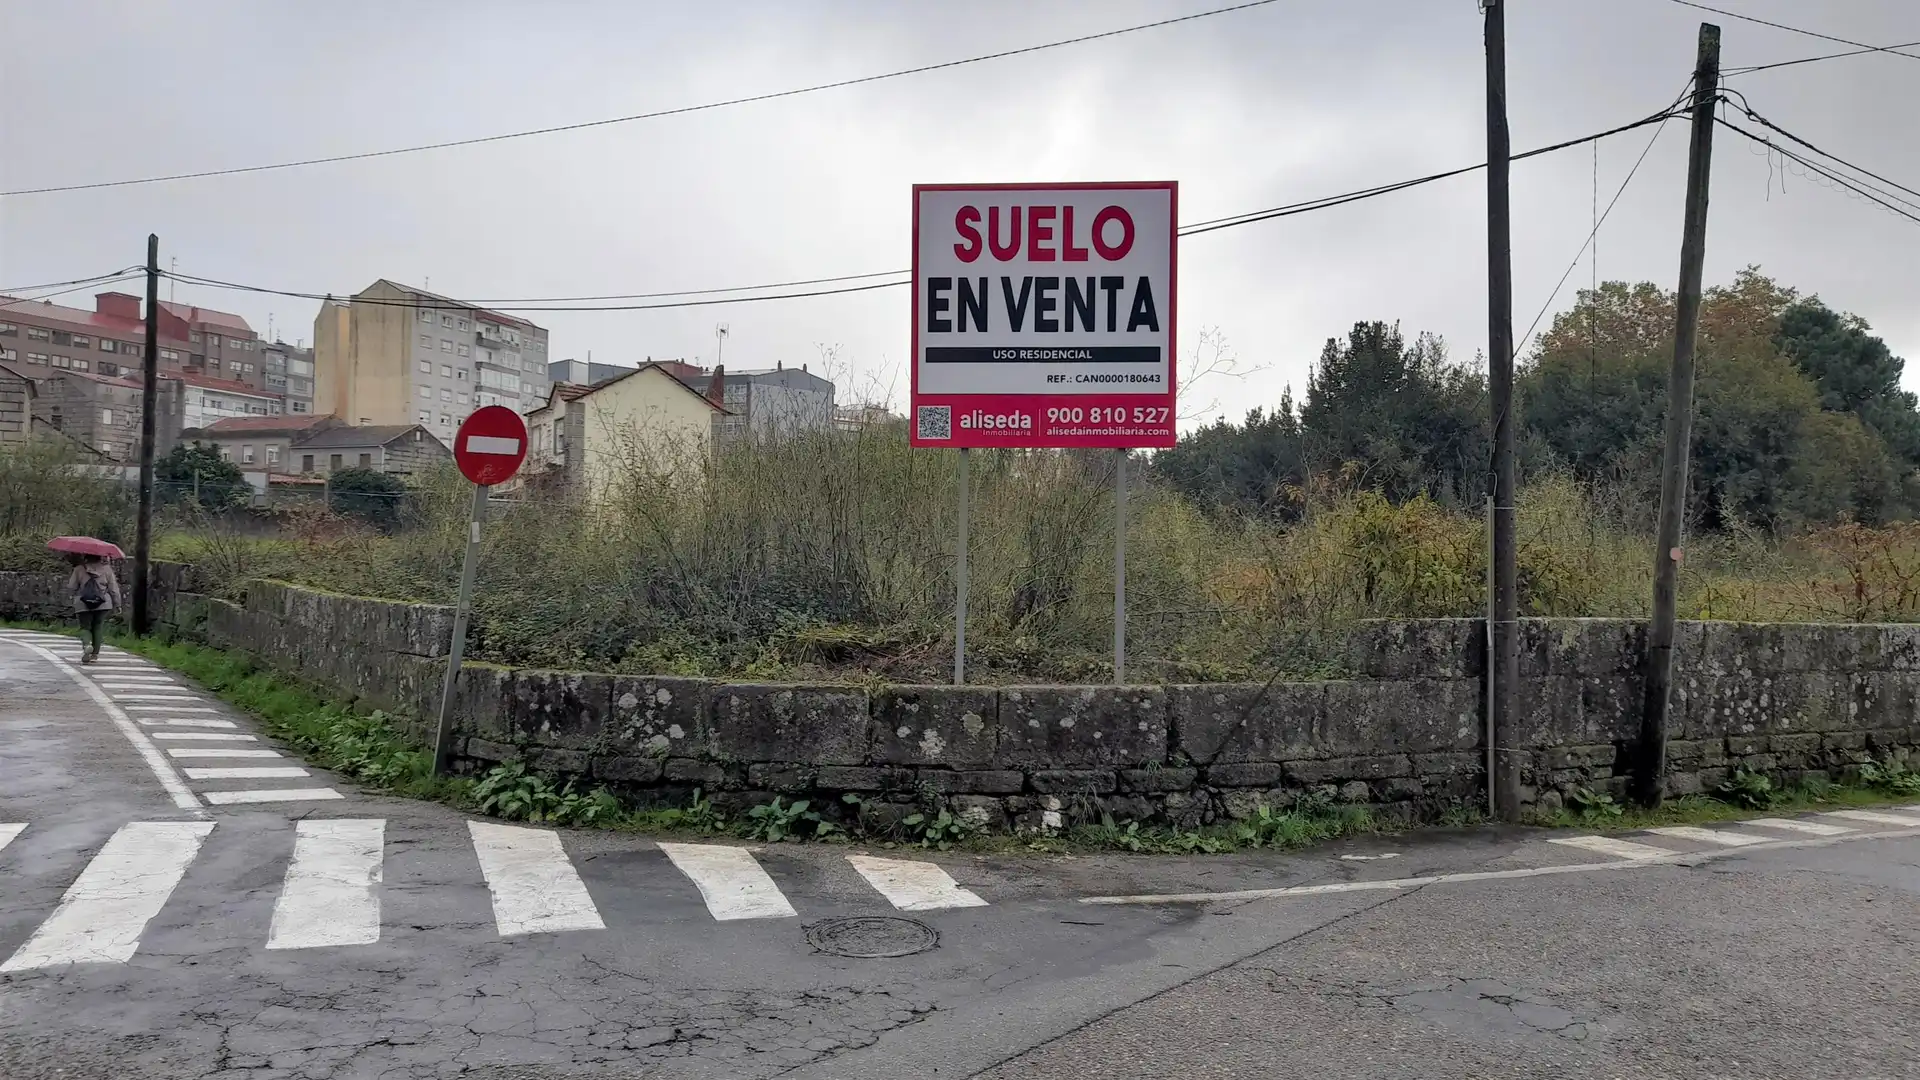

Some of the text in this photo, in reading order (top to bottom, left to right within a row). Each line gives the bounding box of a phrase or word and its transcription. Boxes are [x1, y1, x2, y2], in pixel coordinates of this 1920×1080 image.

[954, 205, 1135, 263] SUELO
[928, 276, 1160, 332] EN VENTA
[993, 350, 1092, 359] USO RESIDENCIAL
[1047, 374, 1160, 383] REF.: CAN0000180643
[960, 410, 1031, 428] aliseda
[1047, 407, 1169, 423] 900 810 527
[1047, 427, 1169, 436] alisedainmobiliaria.com
